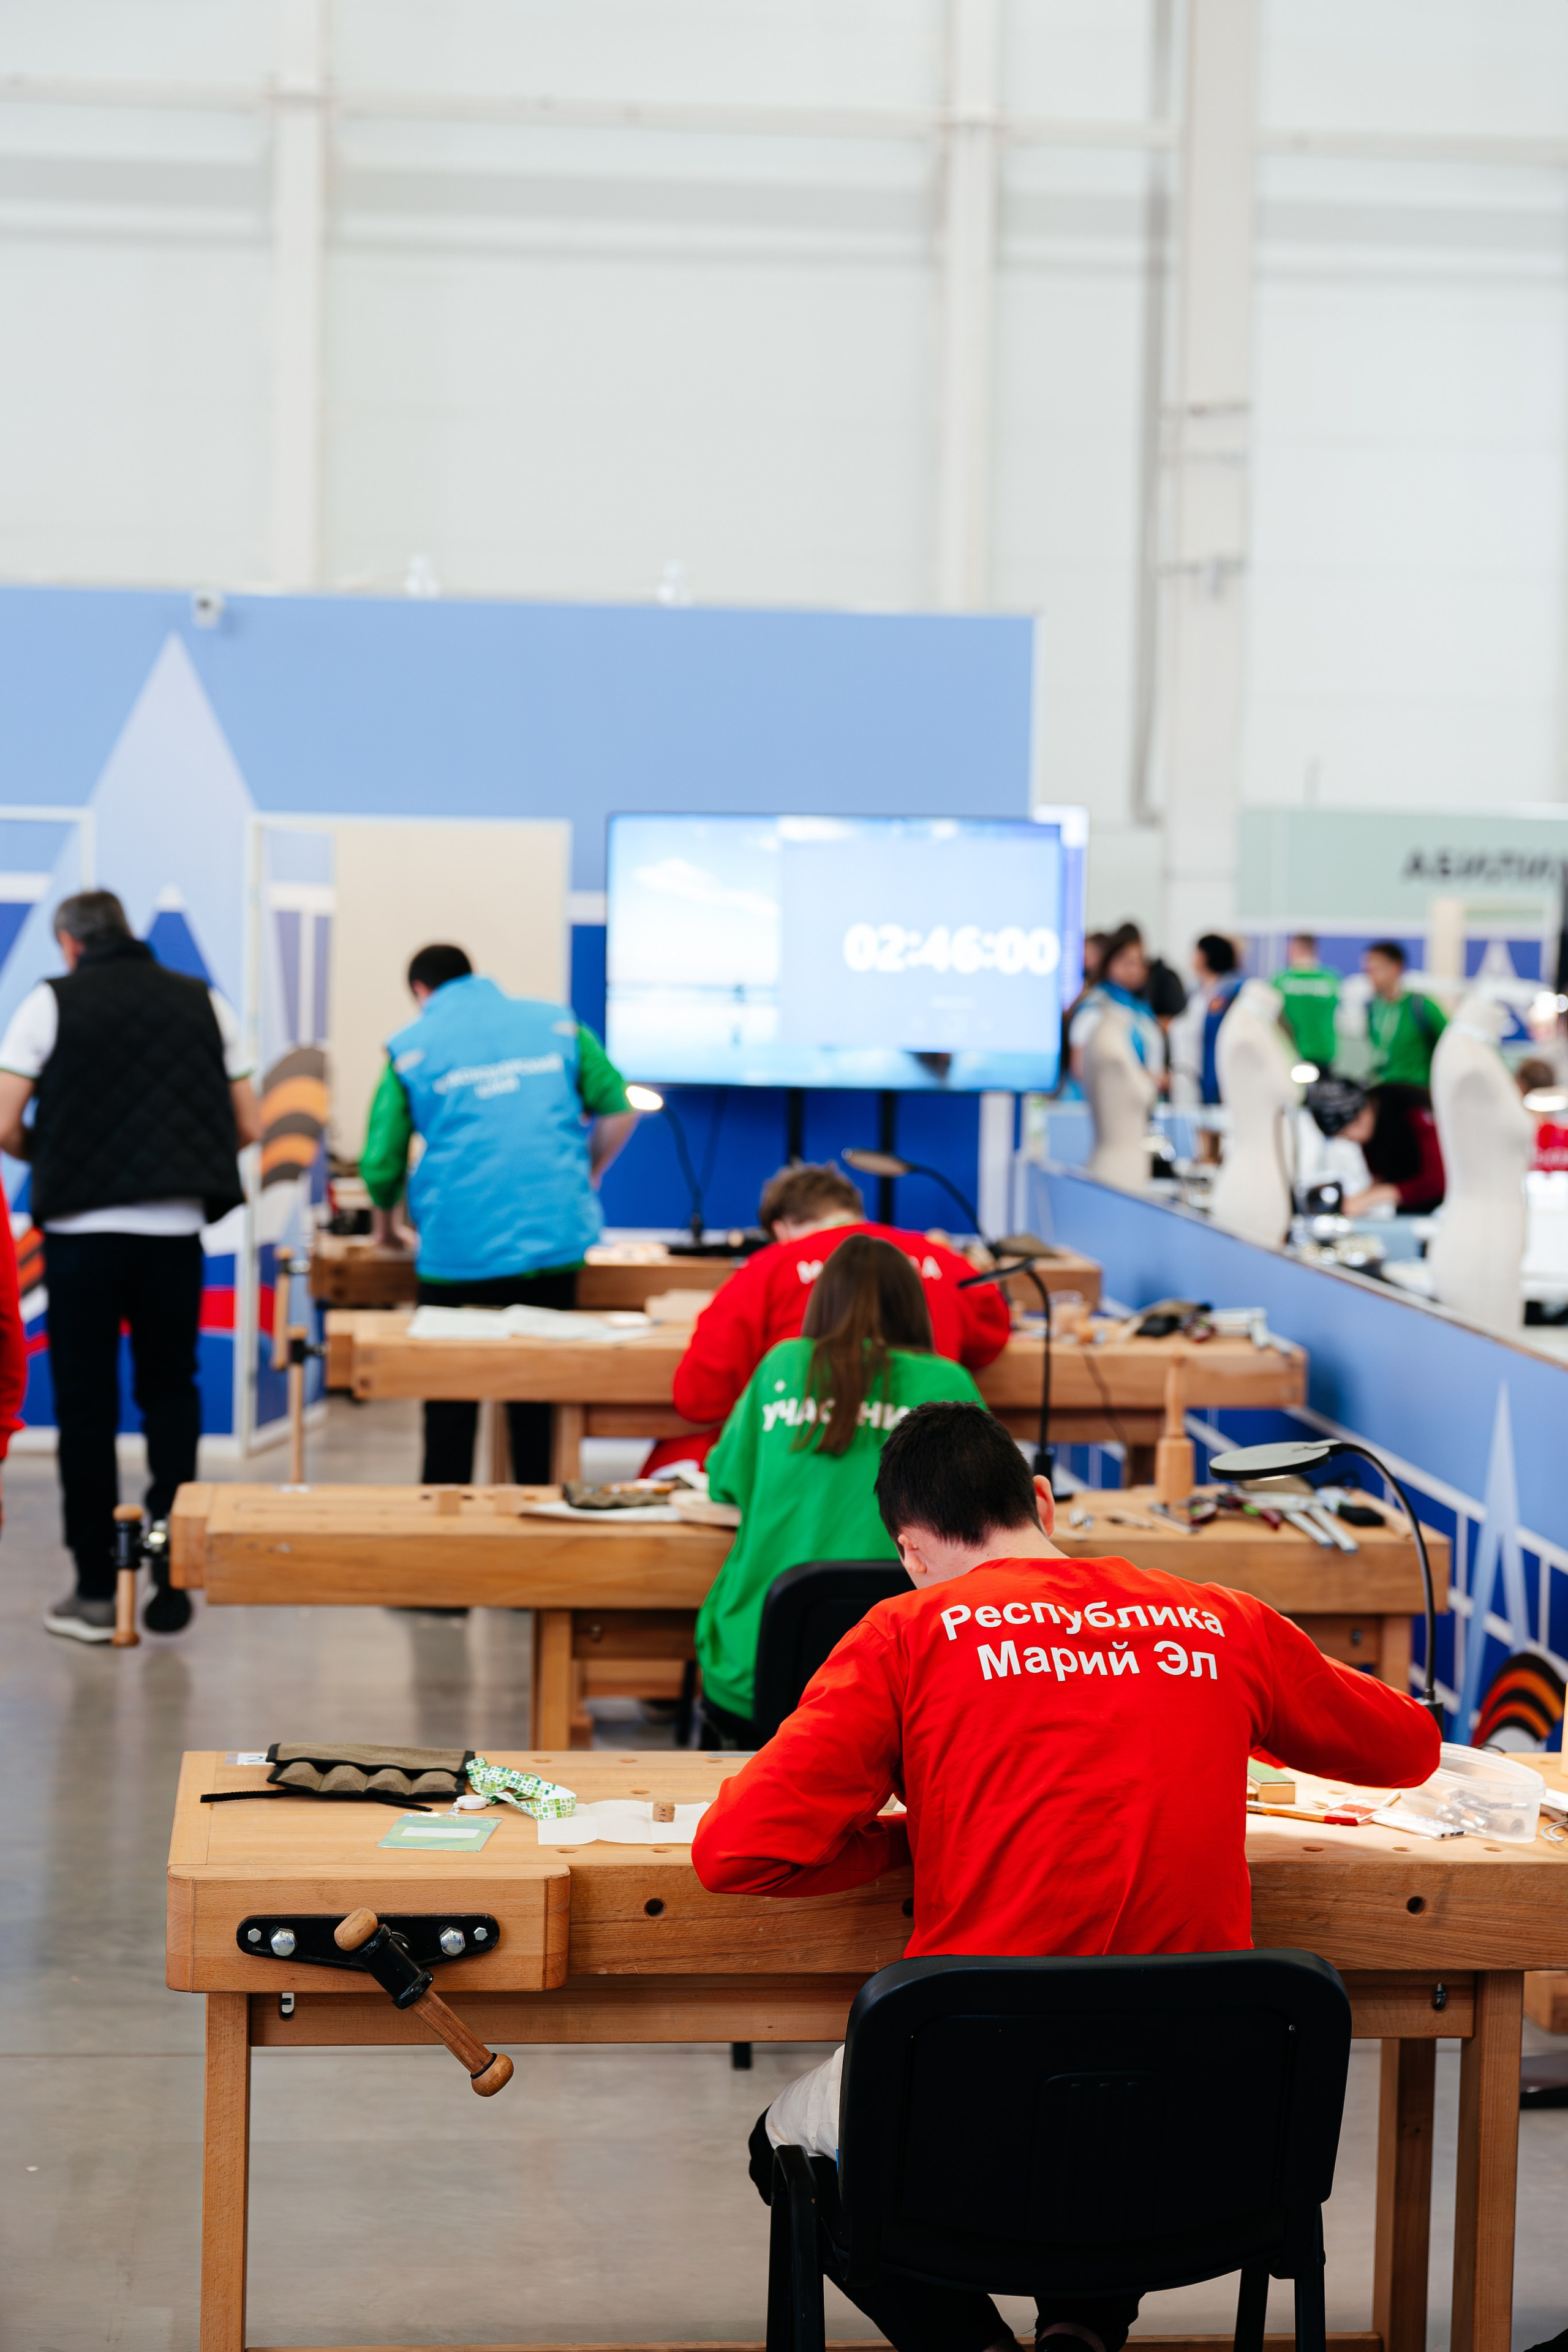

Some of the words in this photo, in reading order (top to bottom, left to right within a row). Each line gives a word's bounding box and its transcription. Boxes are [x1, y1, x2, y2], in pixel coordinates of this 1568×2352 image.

[1400, 848, 1559, 882] АБИЛИ
[843, 922, 1060, 974] 02:46:00
[763, 1396, 910, 1431] УЧАСНИ
[940, 1600, 1225, 1641] Республика
[977, 1640, 1140, 1681] Марий
[1153, 1640, 1218, 1680] Эл
